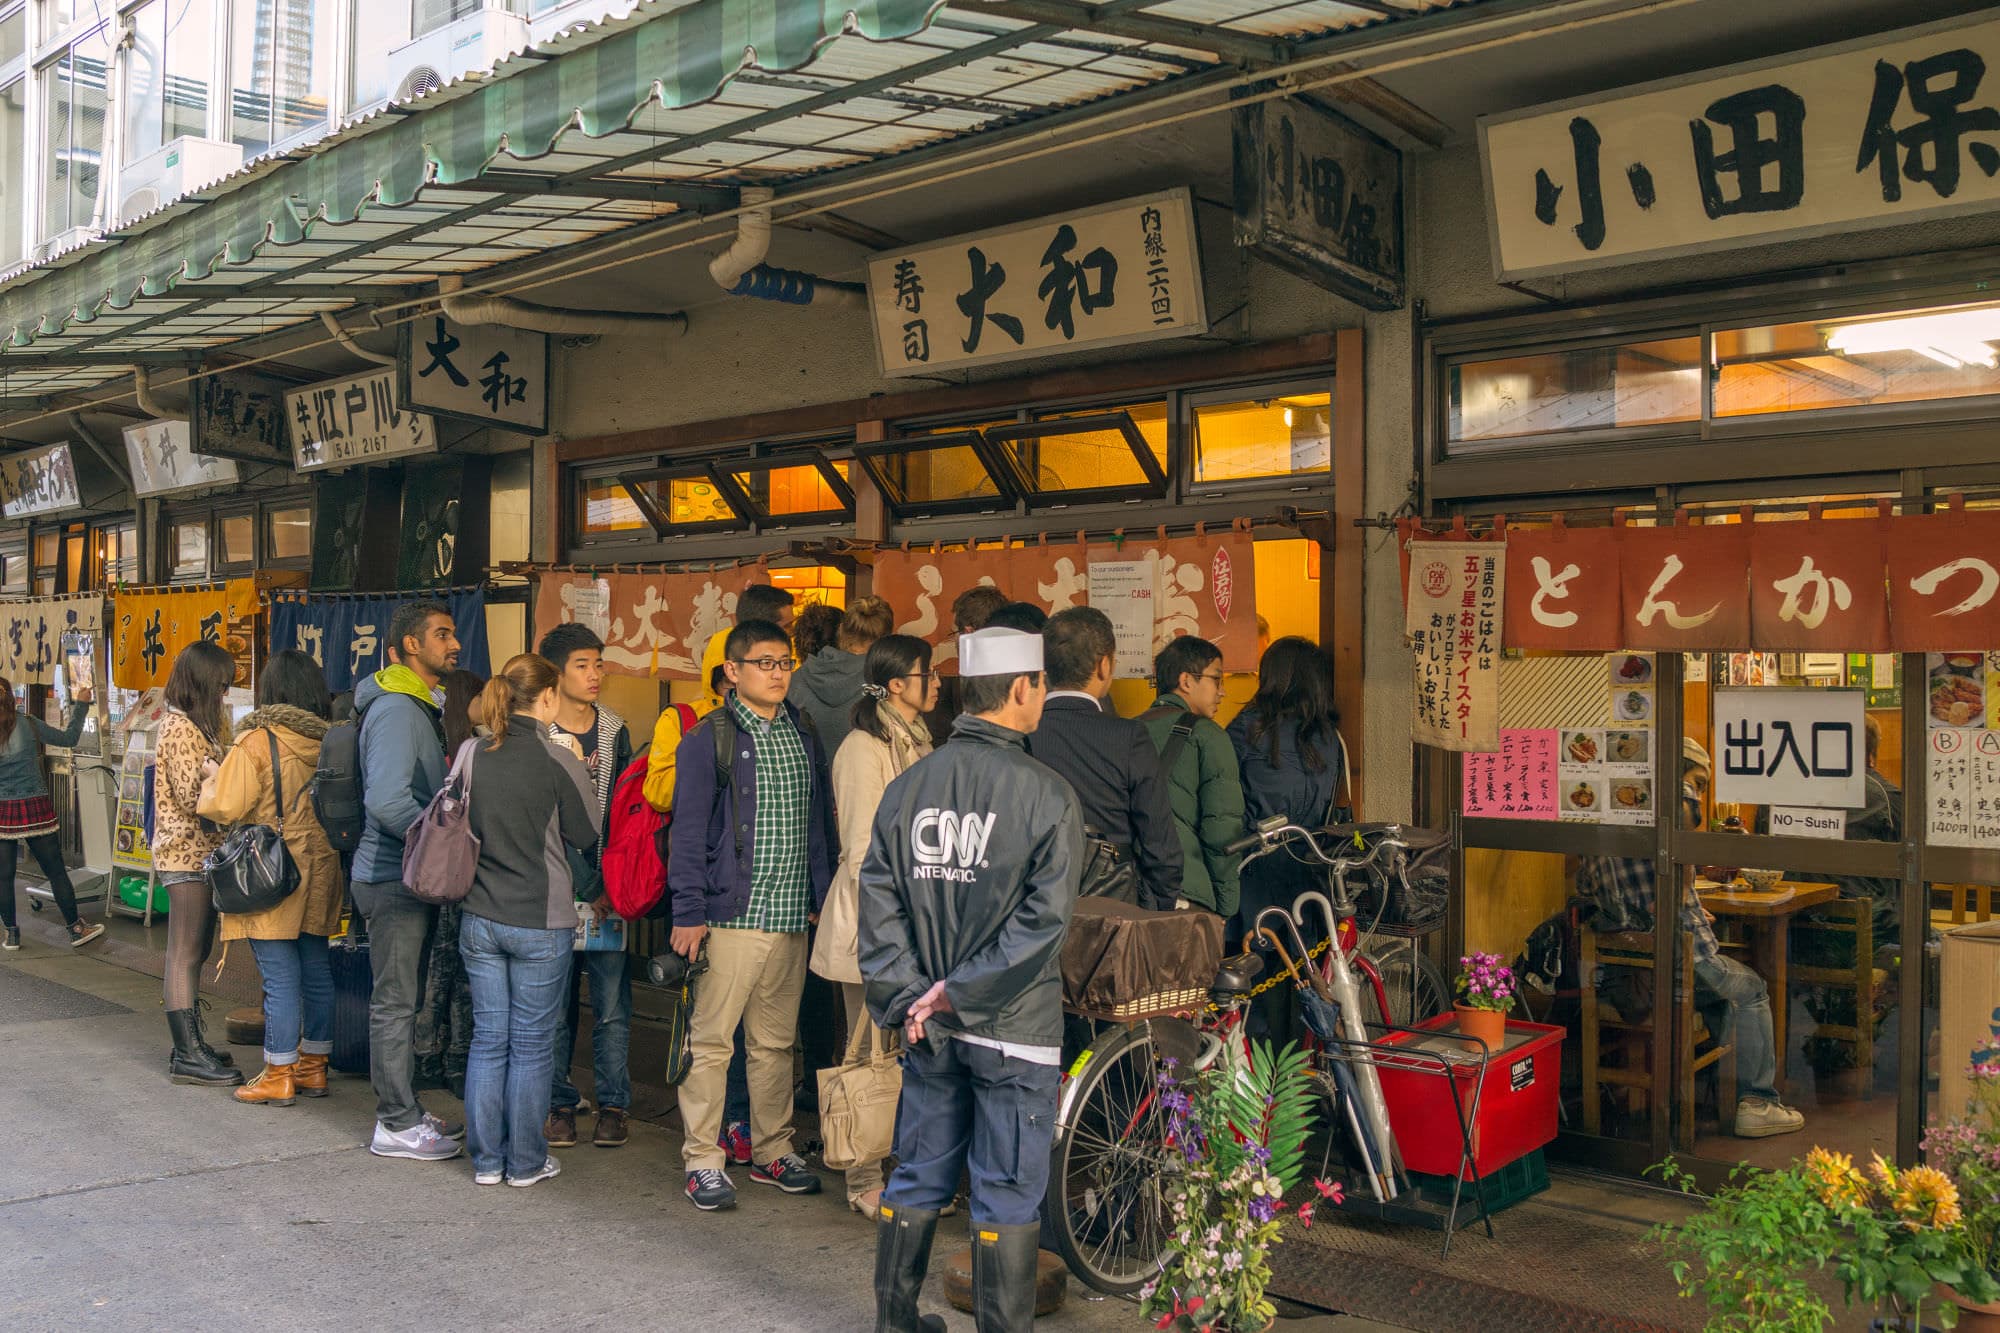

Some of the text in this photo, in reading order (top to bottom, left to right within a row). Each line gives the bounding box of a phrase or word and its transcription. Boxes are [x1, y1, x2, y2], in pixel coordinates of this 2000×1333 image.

[1535, 48, 2000, 251] 小田保
[956, 224, 1118, 354] 大和
[1140, 206, 1175, 326] 内線二六四一
[894, 259, 930, 362] 寿司
[418, 316, 528, 414] 大和
[296, 395, 317, 463] 牛丼
[313, 376, 401, 442] 江戸川
[362, 435, 388, 454] 2167
[1131, 589, 1151, 599] CASH
[1477, 557, 1495, 670] 当店のごはんは
[1531, 554, 2000, 630] とんかつ
[1414, 629, 1427, 725] 使用してます。
[1424, 613, 1442, 728] おいしいお米を
[1439, 613, 1456, 730] がプロデュースした
[1456, 556, 1480, 738] 五ツ星お米マイスター
[1724, 718, 1854, 779] 出入口
[1940, 733, 1953, 749] B
[1982, 733, 2000, 750] A
[911, 808, 997, 868] CNN
[1932, 821, 1968, 834] 1400円
